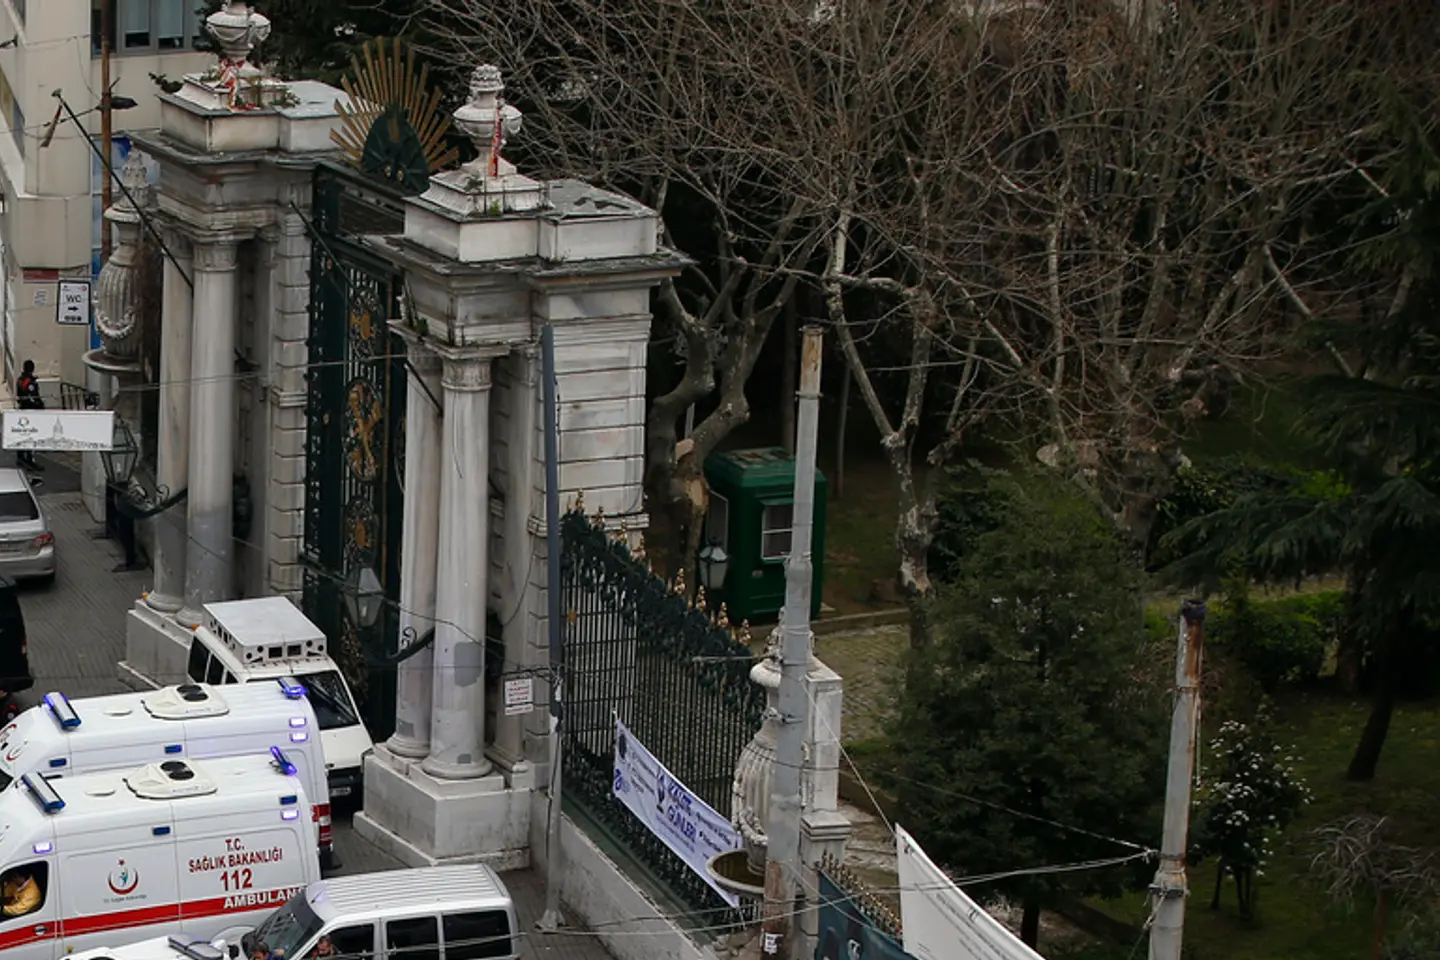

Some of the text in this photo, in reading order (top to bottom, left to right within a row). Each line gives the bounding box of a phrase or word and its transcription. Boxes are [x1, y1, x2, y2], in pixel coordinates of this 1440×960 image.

[66, 294, 82, 303] WC
[225, 838, 245, 851] T.C.
[188, 846, 283, 873] SAĞLIK BAKANLIĞI
[220, 868, 252, 891] 112
